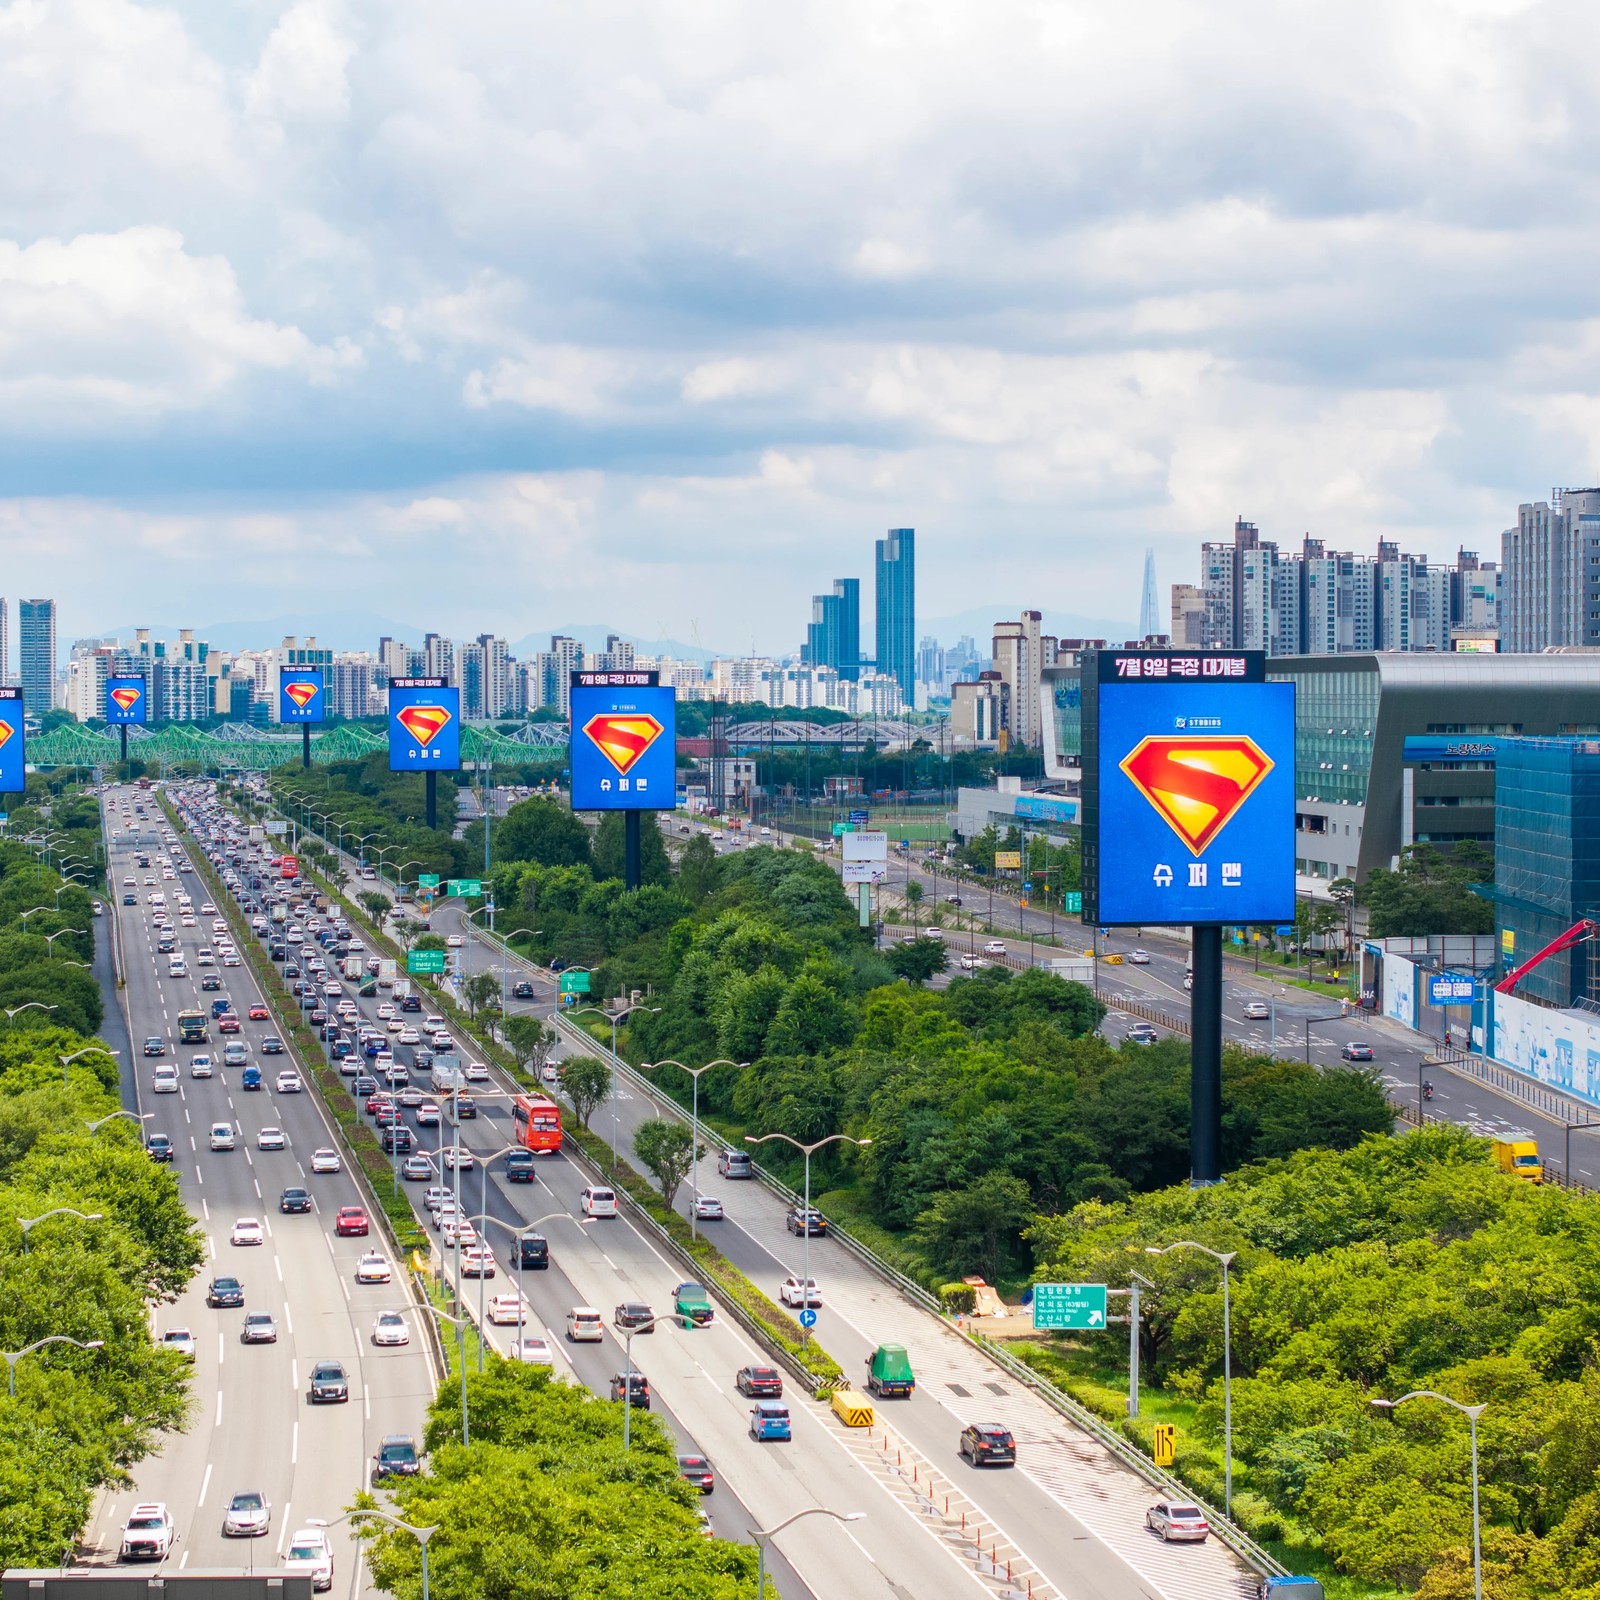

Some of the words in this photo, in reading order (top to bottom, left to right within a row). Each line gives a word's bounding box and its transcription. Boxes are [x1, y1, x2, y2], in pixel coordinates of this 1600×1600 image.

[1115, 658, 1141, 677] 7월
[1143, 658, 1168, 676] 9일
[1170, 658, 1200, 677] 극장
[1202, 658, 1246, 676] 대개봉
[1189, 718, 1222, 727] STUDIOS
[1445, 742, 1498, 756] 노량진수
